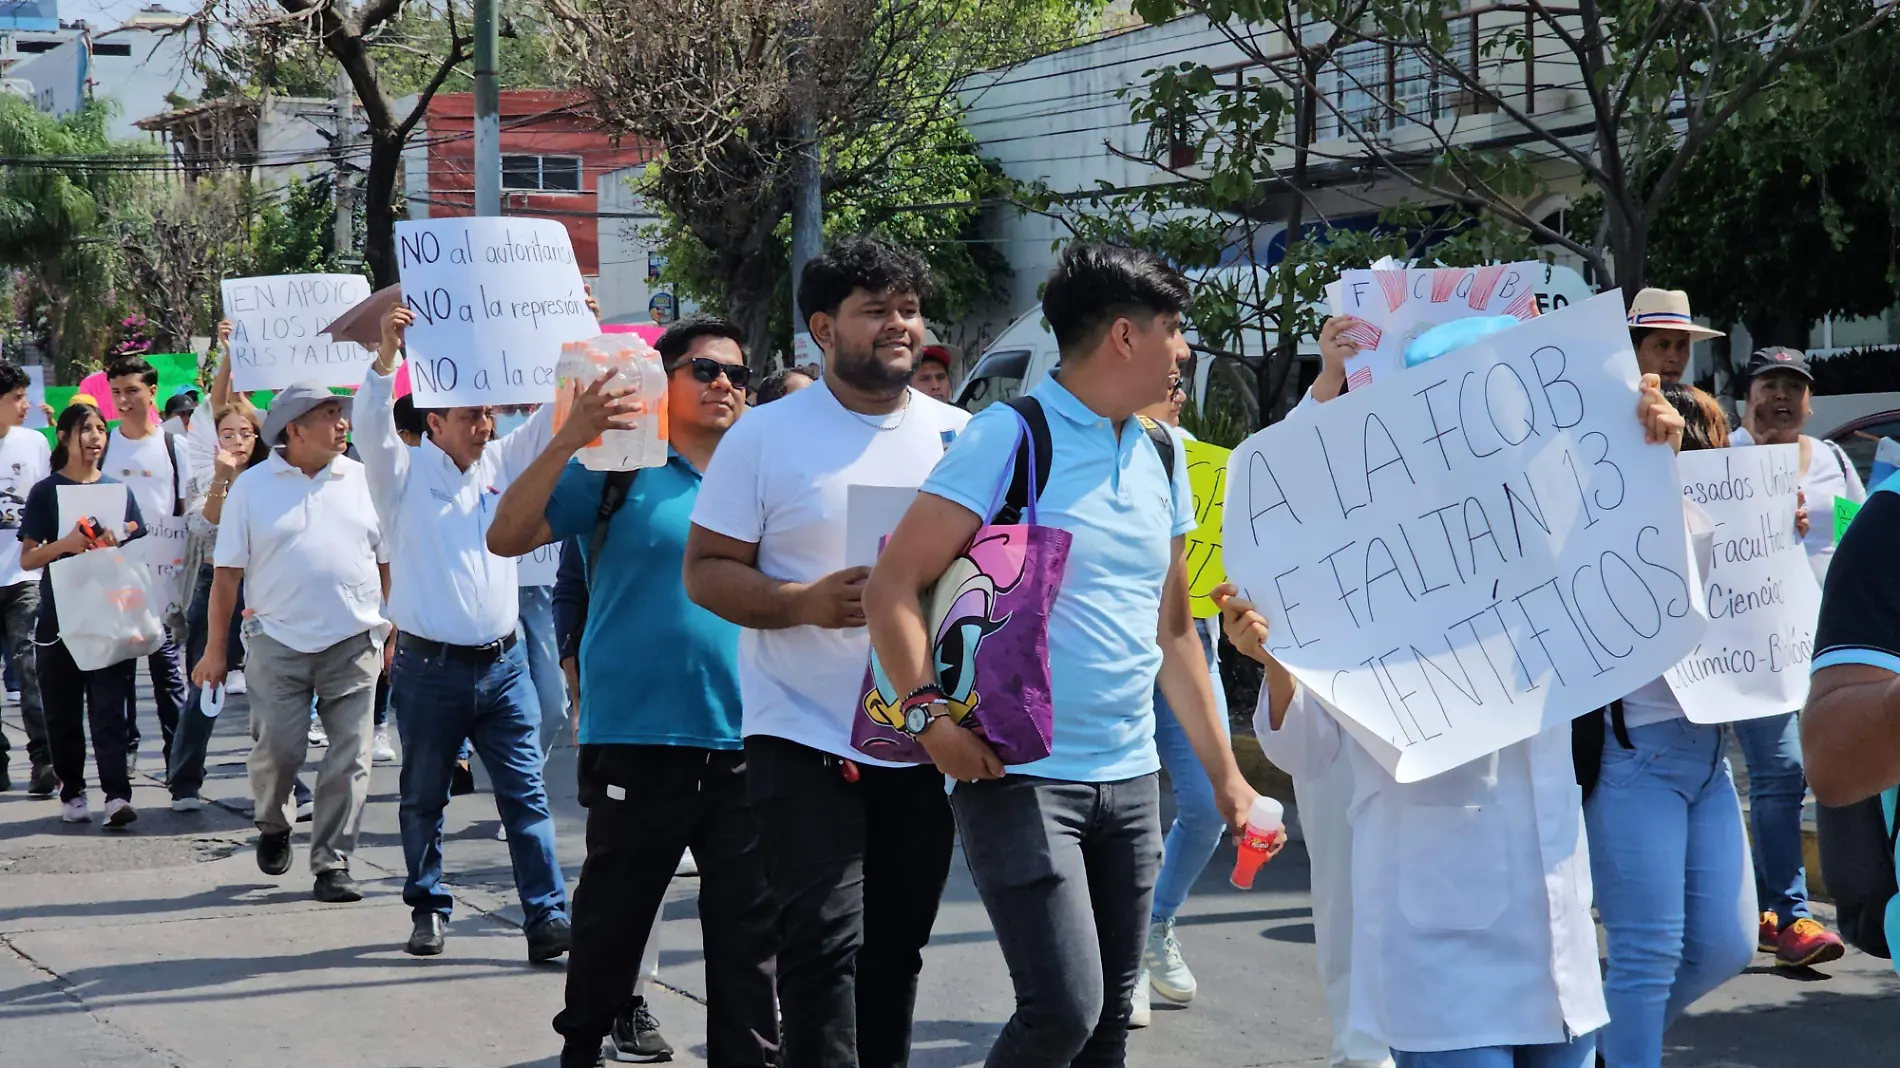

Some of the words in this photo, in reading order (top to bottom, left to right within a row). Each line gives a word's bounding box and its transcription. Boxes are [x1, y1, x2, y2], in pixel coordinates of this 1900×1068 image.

[401, 231, 440, 269] NO
[450, 230, 473, 264] al
[287, 280, 357, 308] APOYO
[406, 288, 451, 327] NO
[459, 304, 474, 323] a
[480, 285, 503, 319] la
[511, 290, 585, 329] represión
[234, 319, 249, 342] A
[261, 316, 305, 341] LOS
[289, 344, 297, 364] Y
[304, 345, 318, 364] A
[415, 357, 457, 393] NO
[474, 368, 491, 391] a
[502, 350, 523, 386] la
[1248, 450, 1302, 546] A
[1315, 412, 1415, 519] LA
[1413, 345, 1584, 471] FCQB
[1319, 471, 1552, 630] FALTAN
[1563, 431, 1625, 531] 13
[1708, 576, 1784, 619] Ciencia
